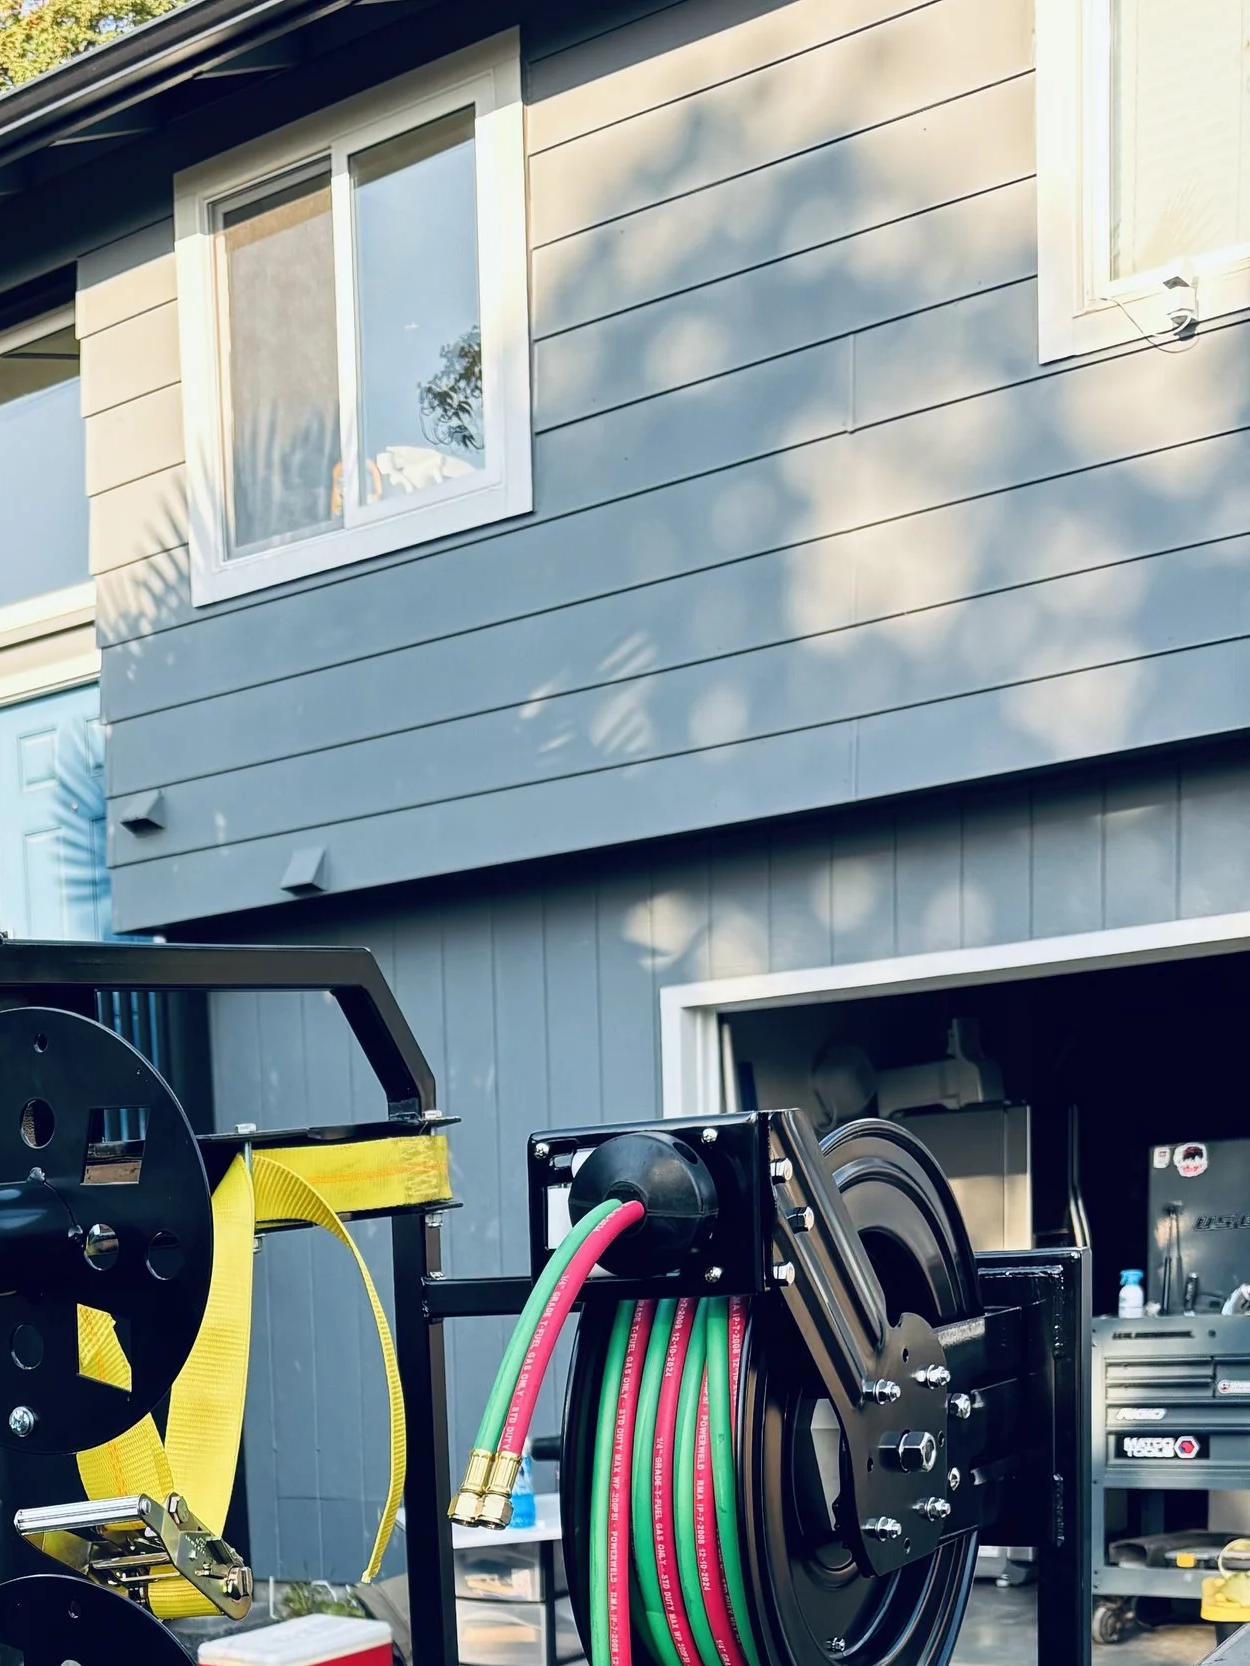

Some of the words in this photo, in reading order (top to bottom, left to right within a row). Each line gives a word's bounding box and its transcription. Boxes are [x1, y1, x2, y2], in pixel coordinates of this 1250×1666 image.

[543, 1291, 561, 1318] GRADE
[633, 1299, 645, 1322] RADE
[523, 1351, 536, 1371] GAS
[664, 1332, 681, 1378] 12-10-2024
[624, 1356, 634, 1375] GAS
[516, 1373, 529, 1397] ONLY
[620, 1377, 631, 1399] ONLY
[508, 1406, 520, 1424] STD
[617, 1408, 627, 1425] STD
[501, 1426, 515, 1451] DUTY
[614, 1427, 625, 1451] DUTY
[656, 1437, 665, 1454] 1/4"
[697, 1415, 709, 1470] POWERWELD
[613, 1453, 622, 1473] MAX
[654, 1457, 663, 1486] GRADE
[612, 1476, 620, 1489] WP
[696, 1480, 704, 1500] RMA
[655, 1523, 665, 1541] GAS
[610, 1531, 618, 1583] POWERWELD
[657, 1544, 667, 1566] ONLY
[699, 1548, 711, 1591] 12-10-2024
[661, 1574, 671, 1589] STD
[610, 1591, 618, 1611] RMA
[663, 1591, 675, 1611] DUTY
[668, 1613, 680, 1629] MAX
